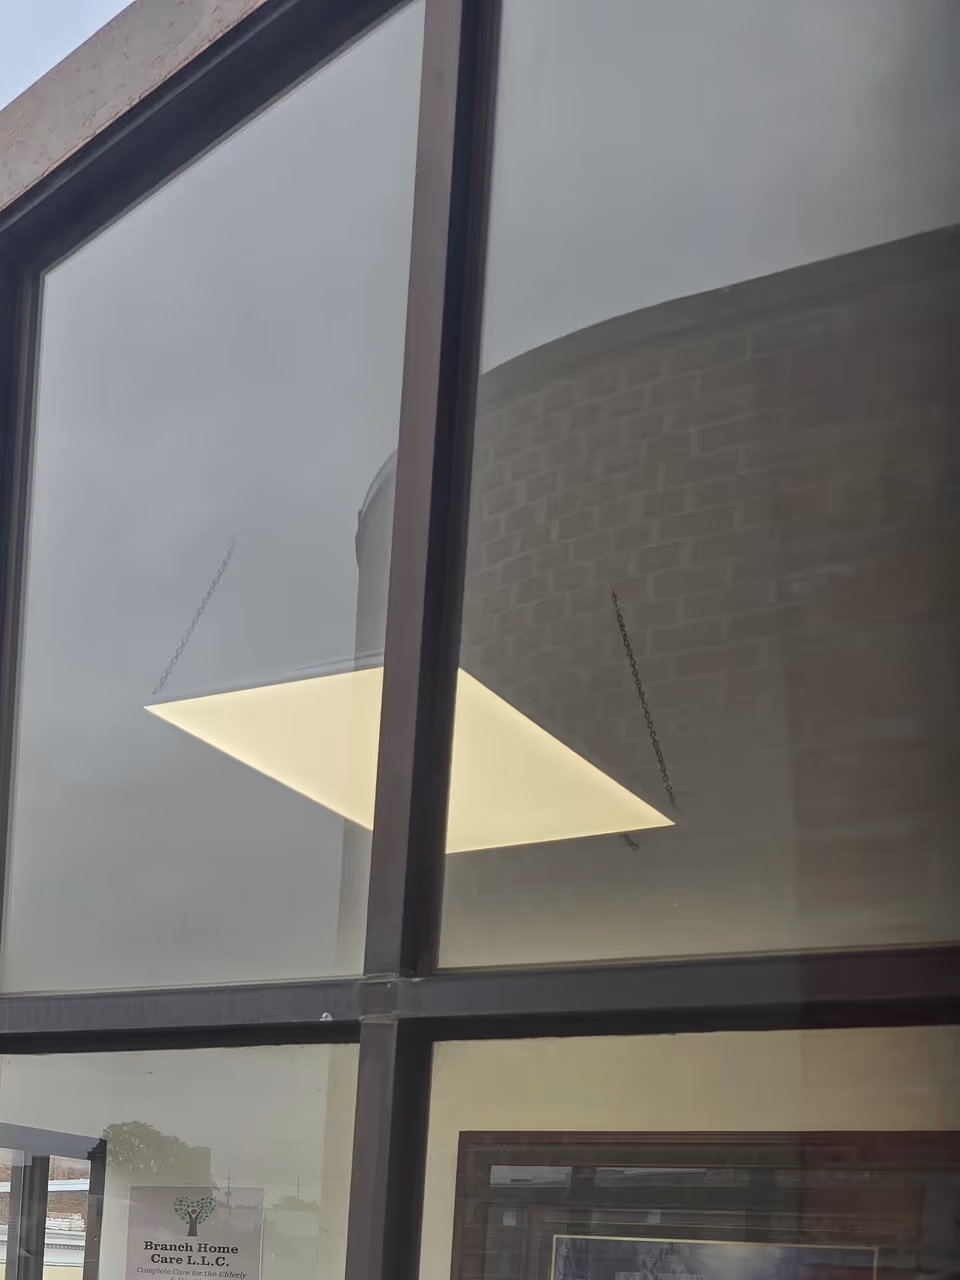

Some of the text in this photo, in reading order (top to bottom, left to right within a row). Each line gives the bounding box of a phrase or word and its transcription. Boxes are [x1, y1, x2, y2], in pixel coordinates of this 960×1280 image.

[143, 1240, 239, 1255] Branch Home
[150, 1253, 230, 1268] Care L.L.C.
[136, 1266, 172, 1276] Complete
[172, 1268, 190, 1277] Care
[191, 1269, 202, 1277] for
[218, 1271, 248, 1280] Elderly
